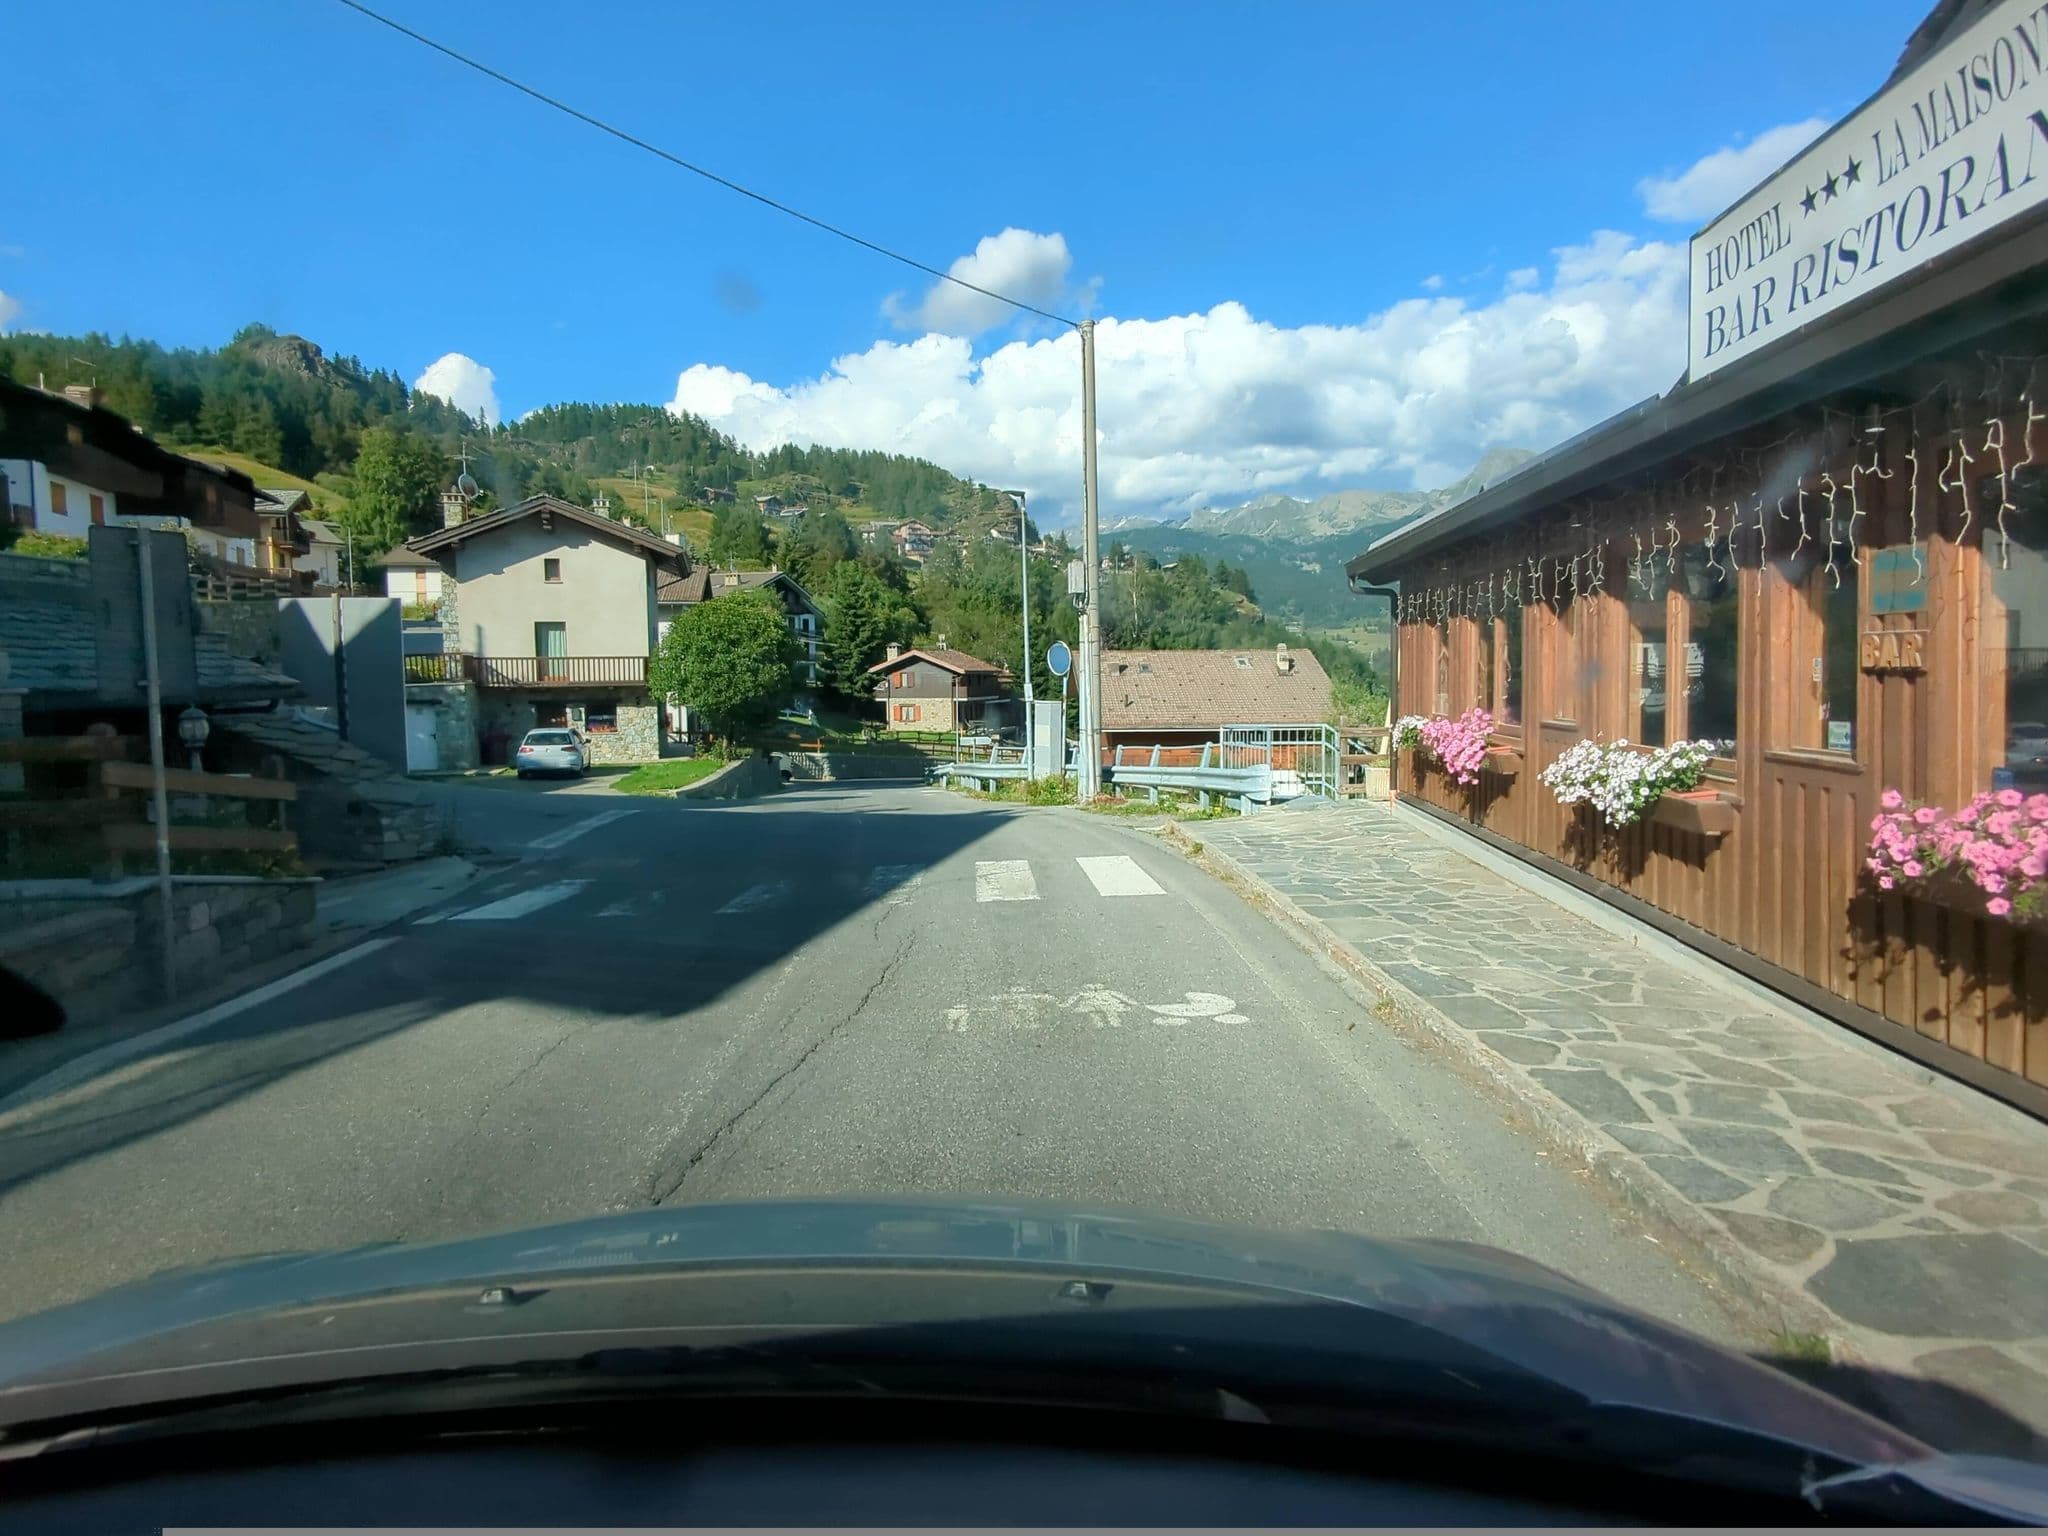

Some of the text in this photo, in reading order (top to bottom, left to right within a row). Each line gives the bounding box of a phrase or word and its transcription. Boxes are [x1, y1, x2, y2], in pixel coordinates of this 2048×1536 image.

[1705, 2, 2048, 295] HOTEL LA MAISON
[1703, 276, 1777, 359] BAR
[1861, 633, 1924, 669] BAR
